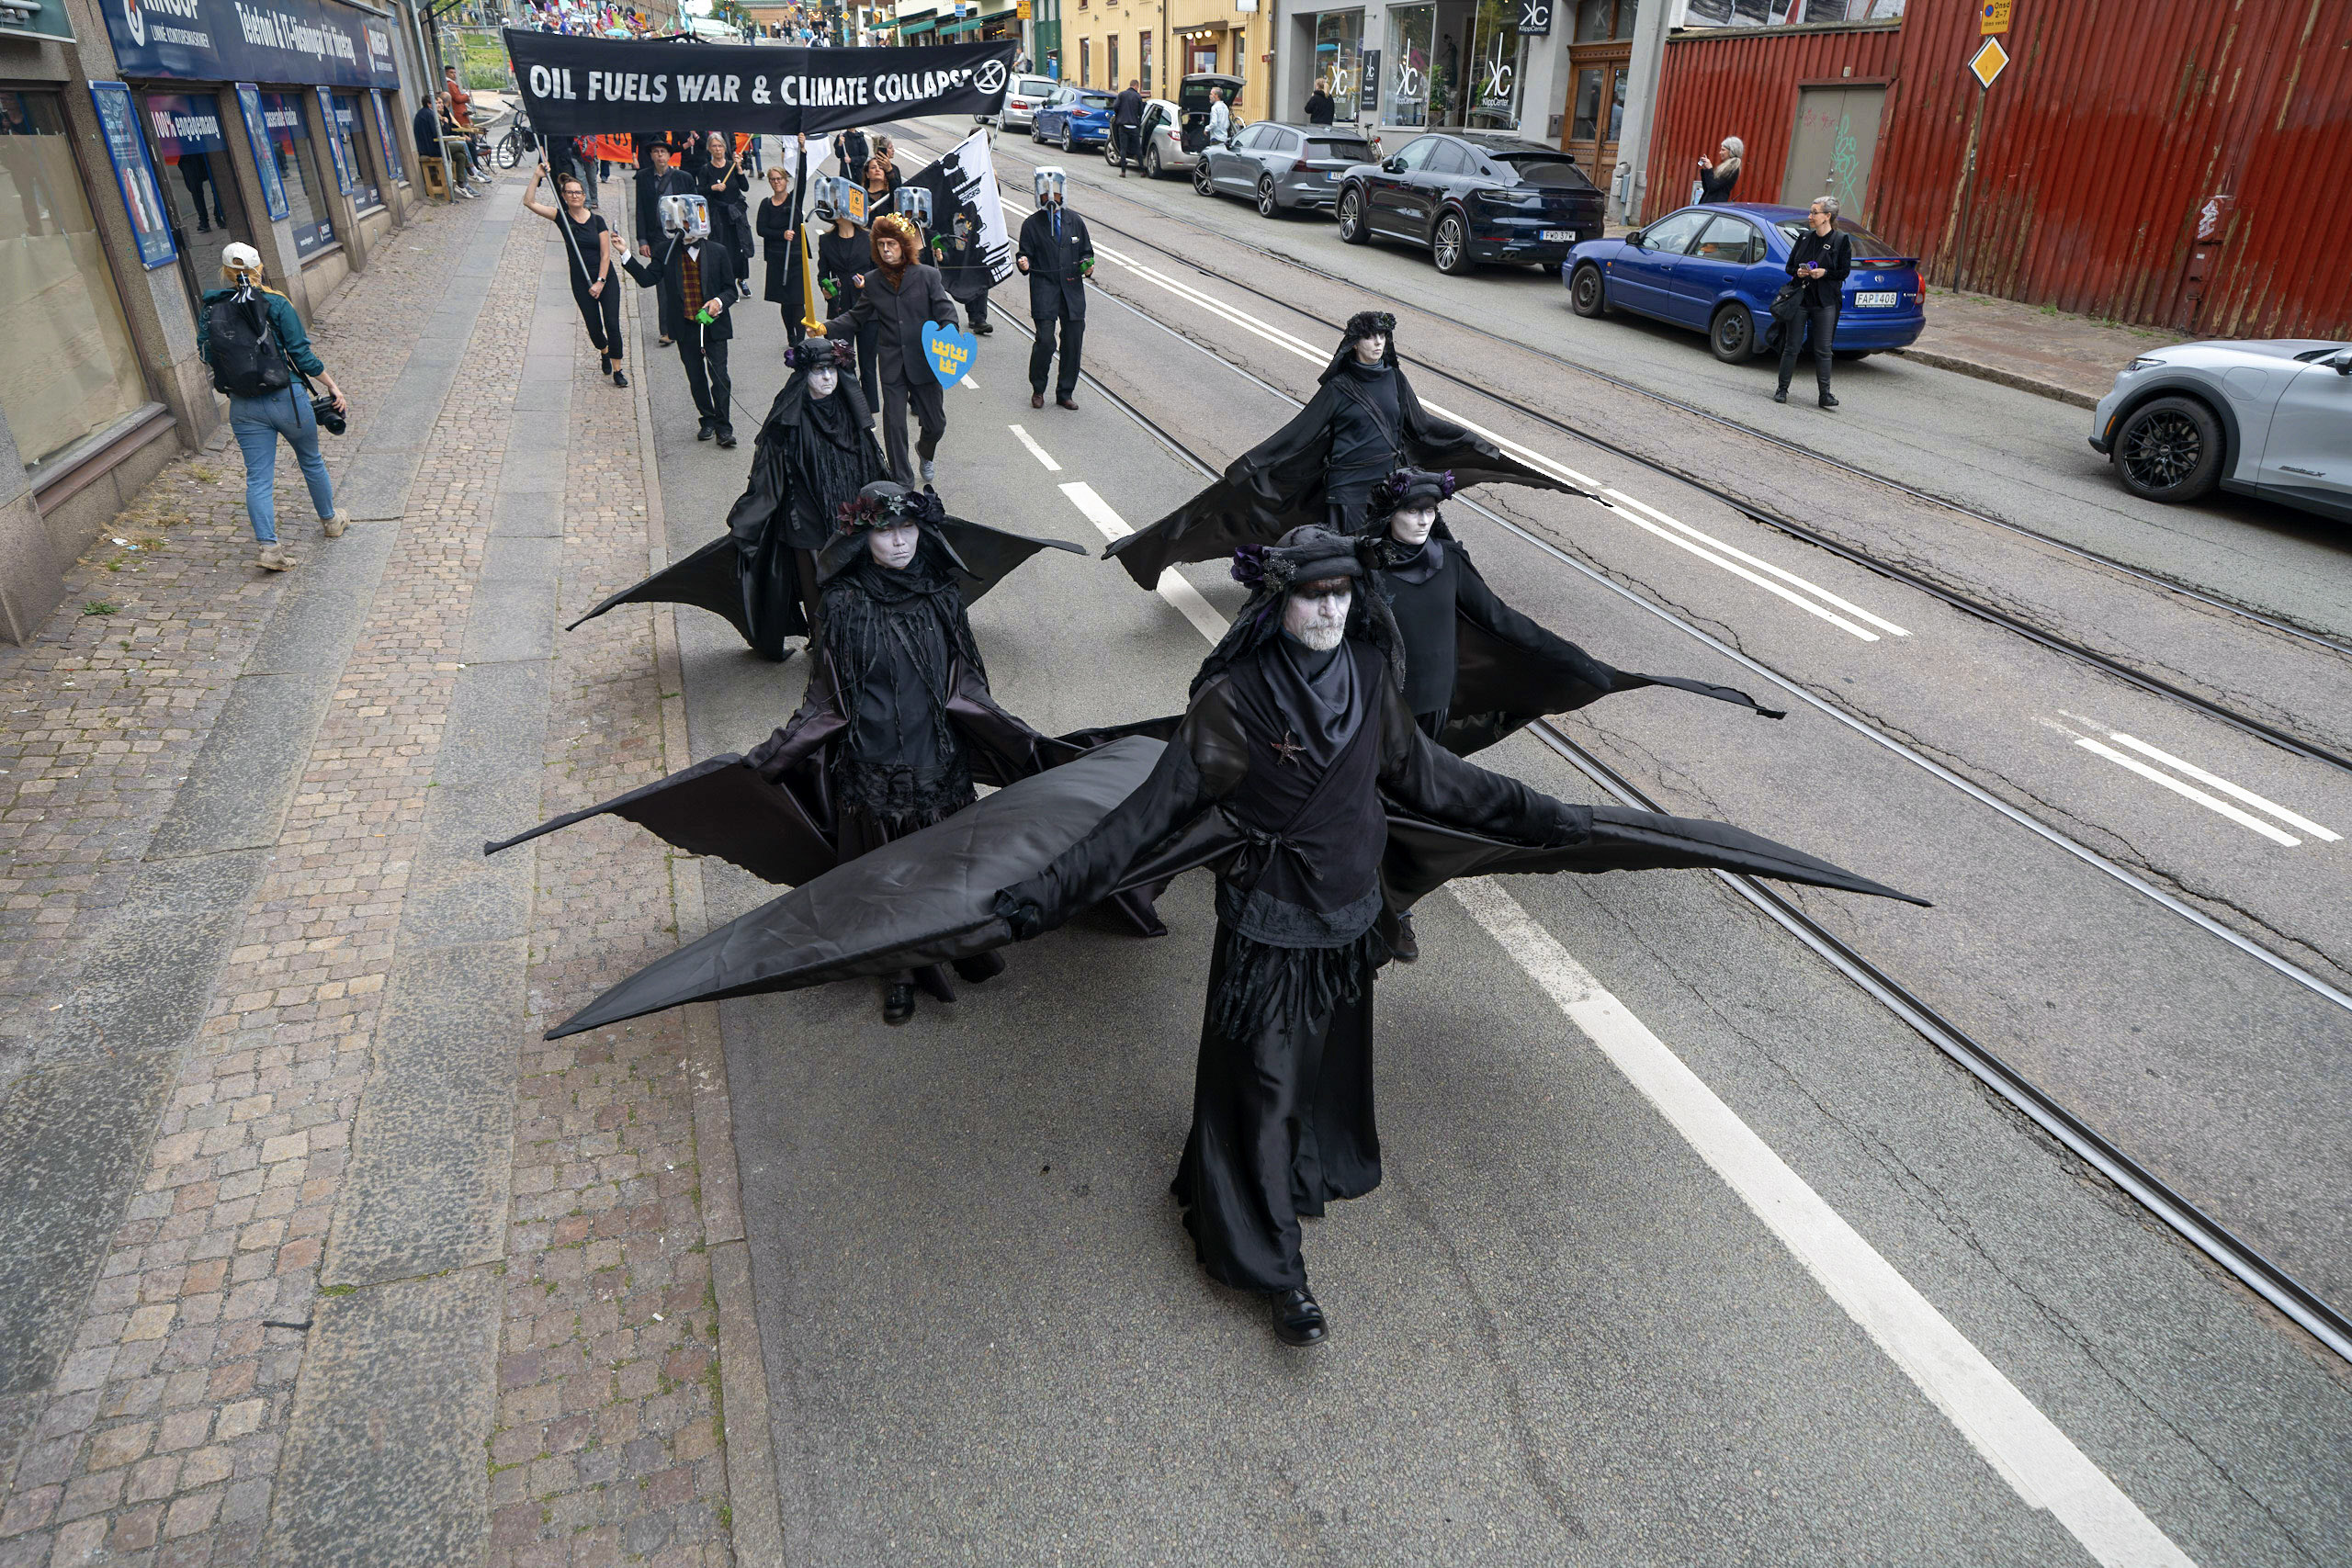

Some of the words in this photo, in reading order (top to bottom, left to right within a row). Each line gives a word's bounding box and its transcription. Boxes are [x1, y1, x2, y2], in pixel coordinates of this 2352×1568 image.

[1995, 10, 2007, 18] 2-7
[234, 2, 277, 47] Telefoni
[273, 11, 286, 49] &
[530, 64, 577, 100] OIL
[588, 71, 668, 103] FUELS
[676, 74, 741, 103] WAR
[752, 75, 772, 104] &
[781, 75, 868, 107] CLIMATE
[1482, 98, 1510, 107] KlippCenter
[151, 111, 176, 138] 100%
[175, 116, 220, 141] engagemang
[1858, 293, 1874, 303] FAP
[1880, 293, 1895, 303] 408
